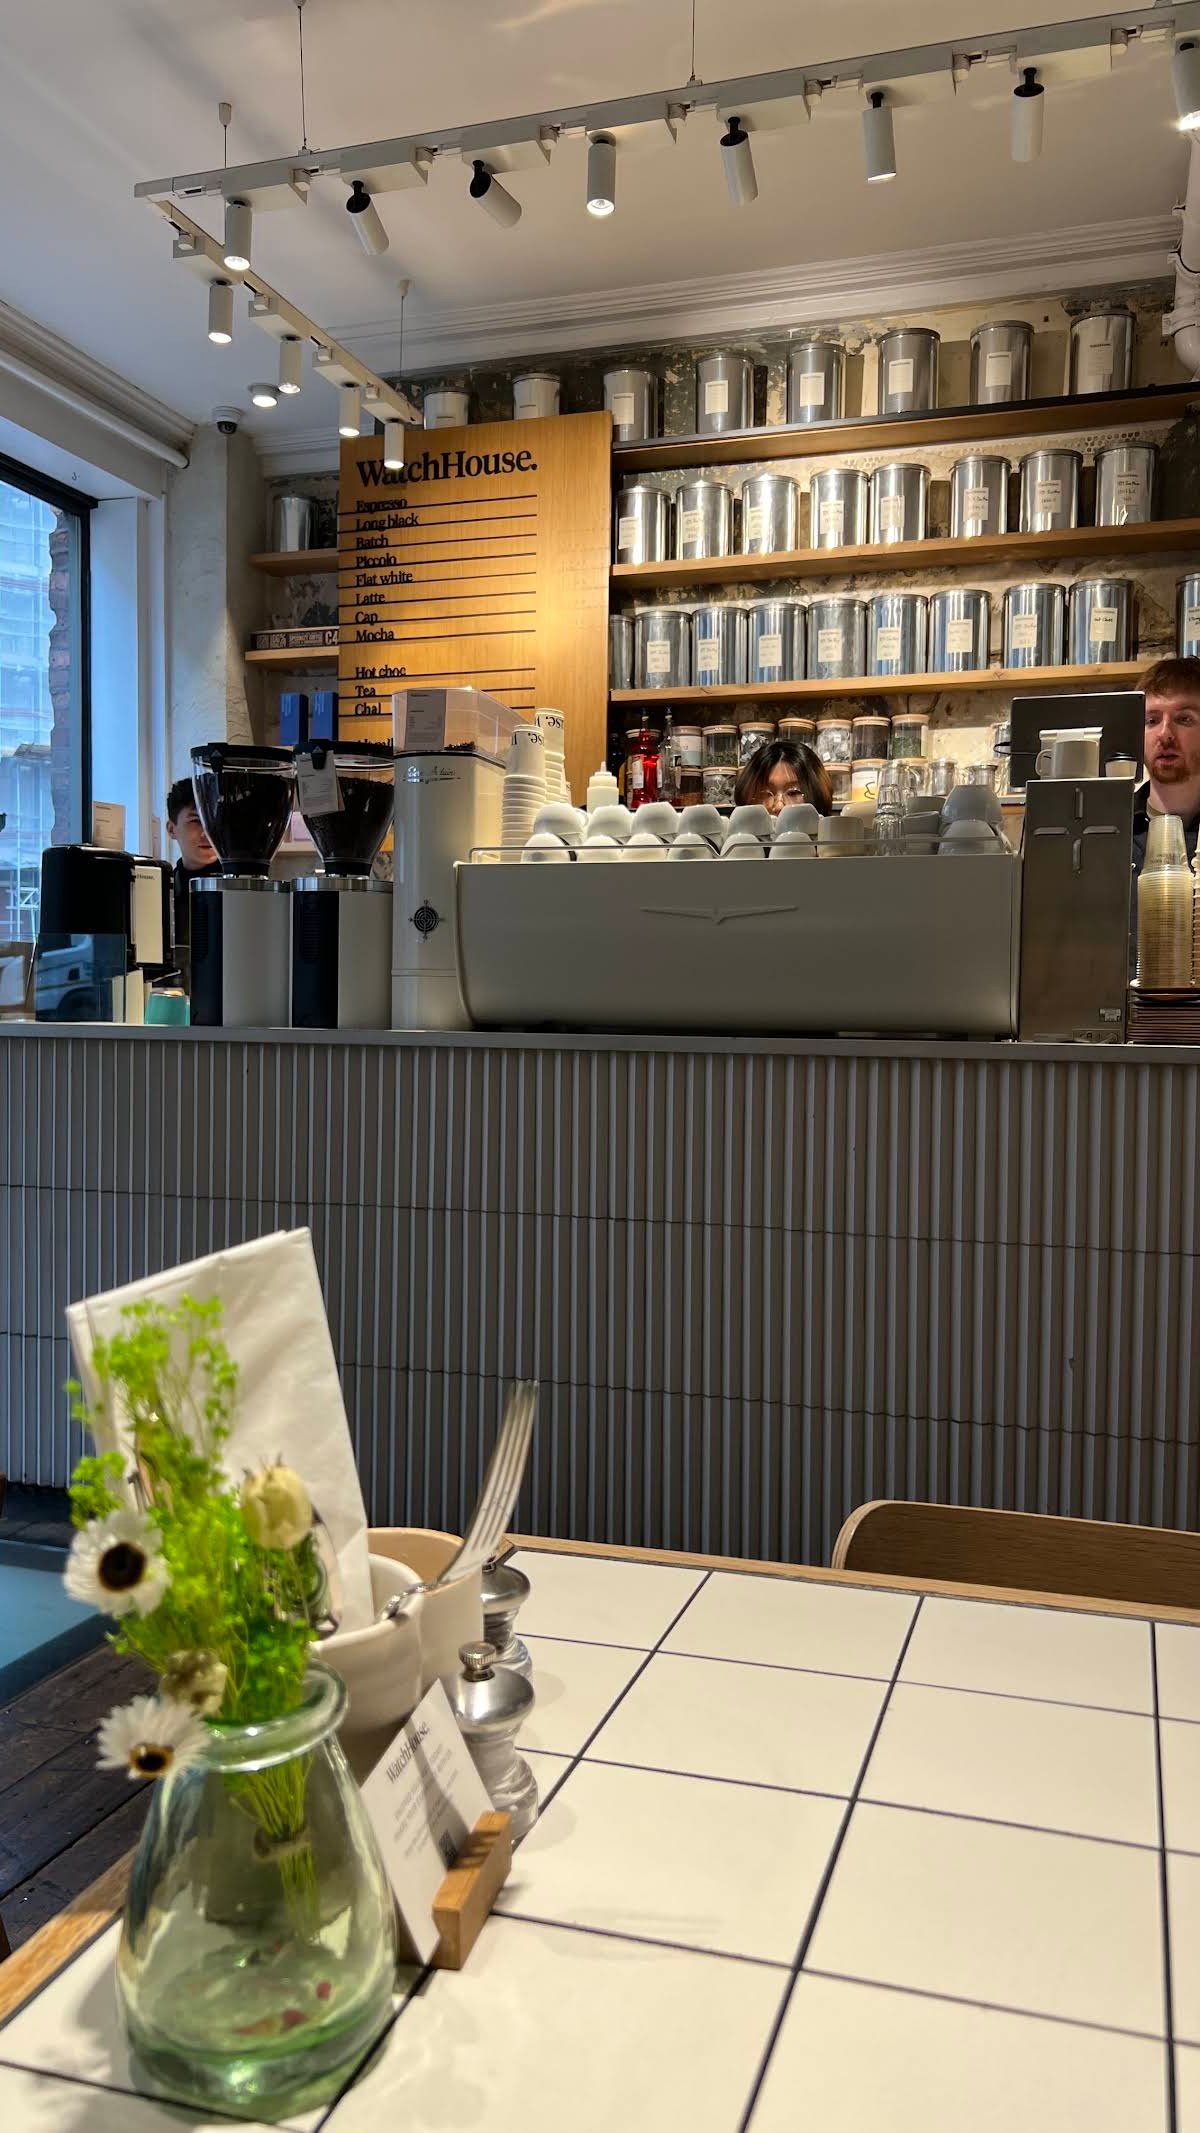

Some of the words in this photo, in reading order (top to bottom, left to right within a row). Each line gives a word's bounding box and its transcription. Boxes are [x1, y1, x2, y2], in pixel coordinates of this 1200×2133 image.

[356, 450, 538, 488] WatchHouse.
[356, 498, 408, 514] Espresso
[356, 519, 386, 532] Long
[387, 512, 420, 528] black
[356, 534, 389, 549] Batch
[356, 552, 397, 568] Piccolo
[356, 573, 378, 587] Flat
[379, 571, 413, 585] white
[355, 593, 386, 605] Latte
[355, 611, 379, 626] Cap
[356, 627, 395, 642] Mocha
[355, 666, 377, 679] Hot
[378, 664, 407, 678] choc
[354, 685, 376, 698] Tea
